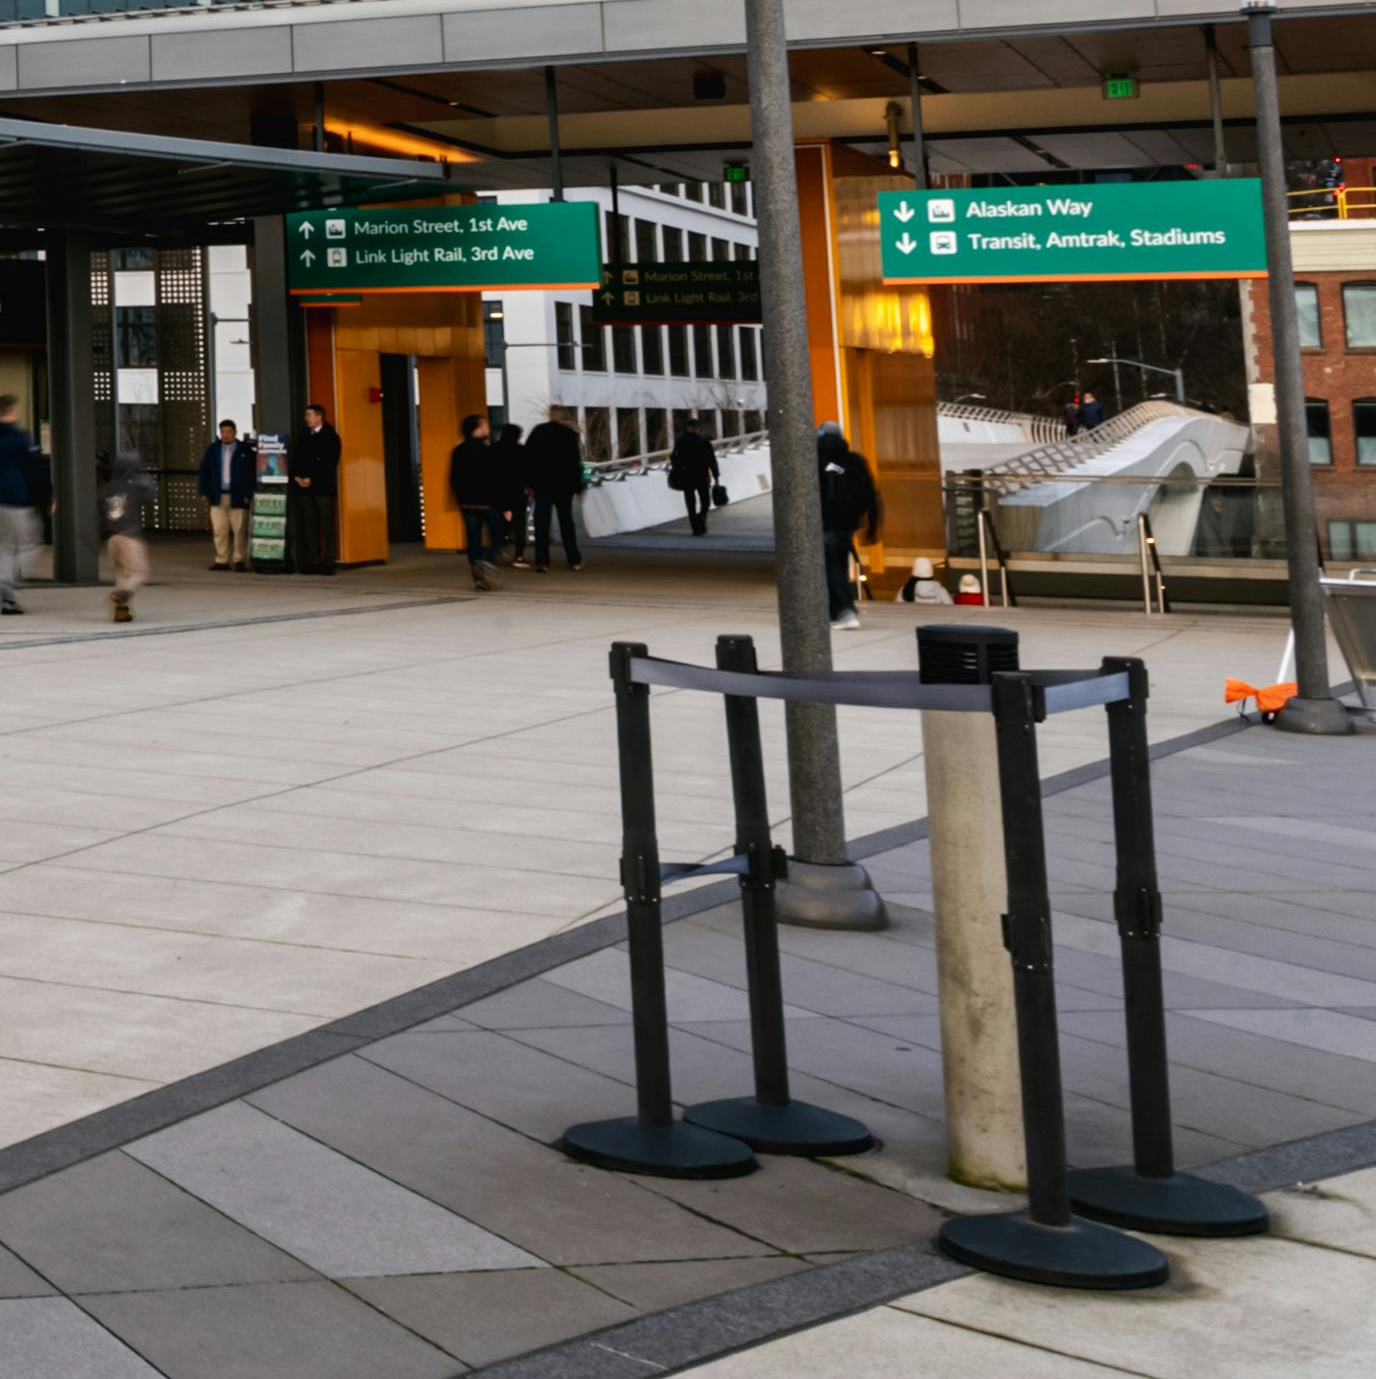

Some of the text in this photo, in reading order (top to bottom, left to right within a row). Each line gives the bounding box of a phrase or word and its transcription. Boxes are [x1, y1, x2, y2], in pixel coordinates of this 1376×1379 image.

[966, 199, 1093, 218] Alaskan Way
[354, 217, 528, 235] Marion Street, 1st Ave
[968, 228, 1226, 250] Transit, Amtrak, Stadiums
[356, 246, 535, 266] Link Light Rail, 3rd Ave
[644, 272, 688, 282] Marion
[736, 270, 753, 281] 1st
[646, 293, 670, 303] Link
[674, 292, 704, 306] Light
